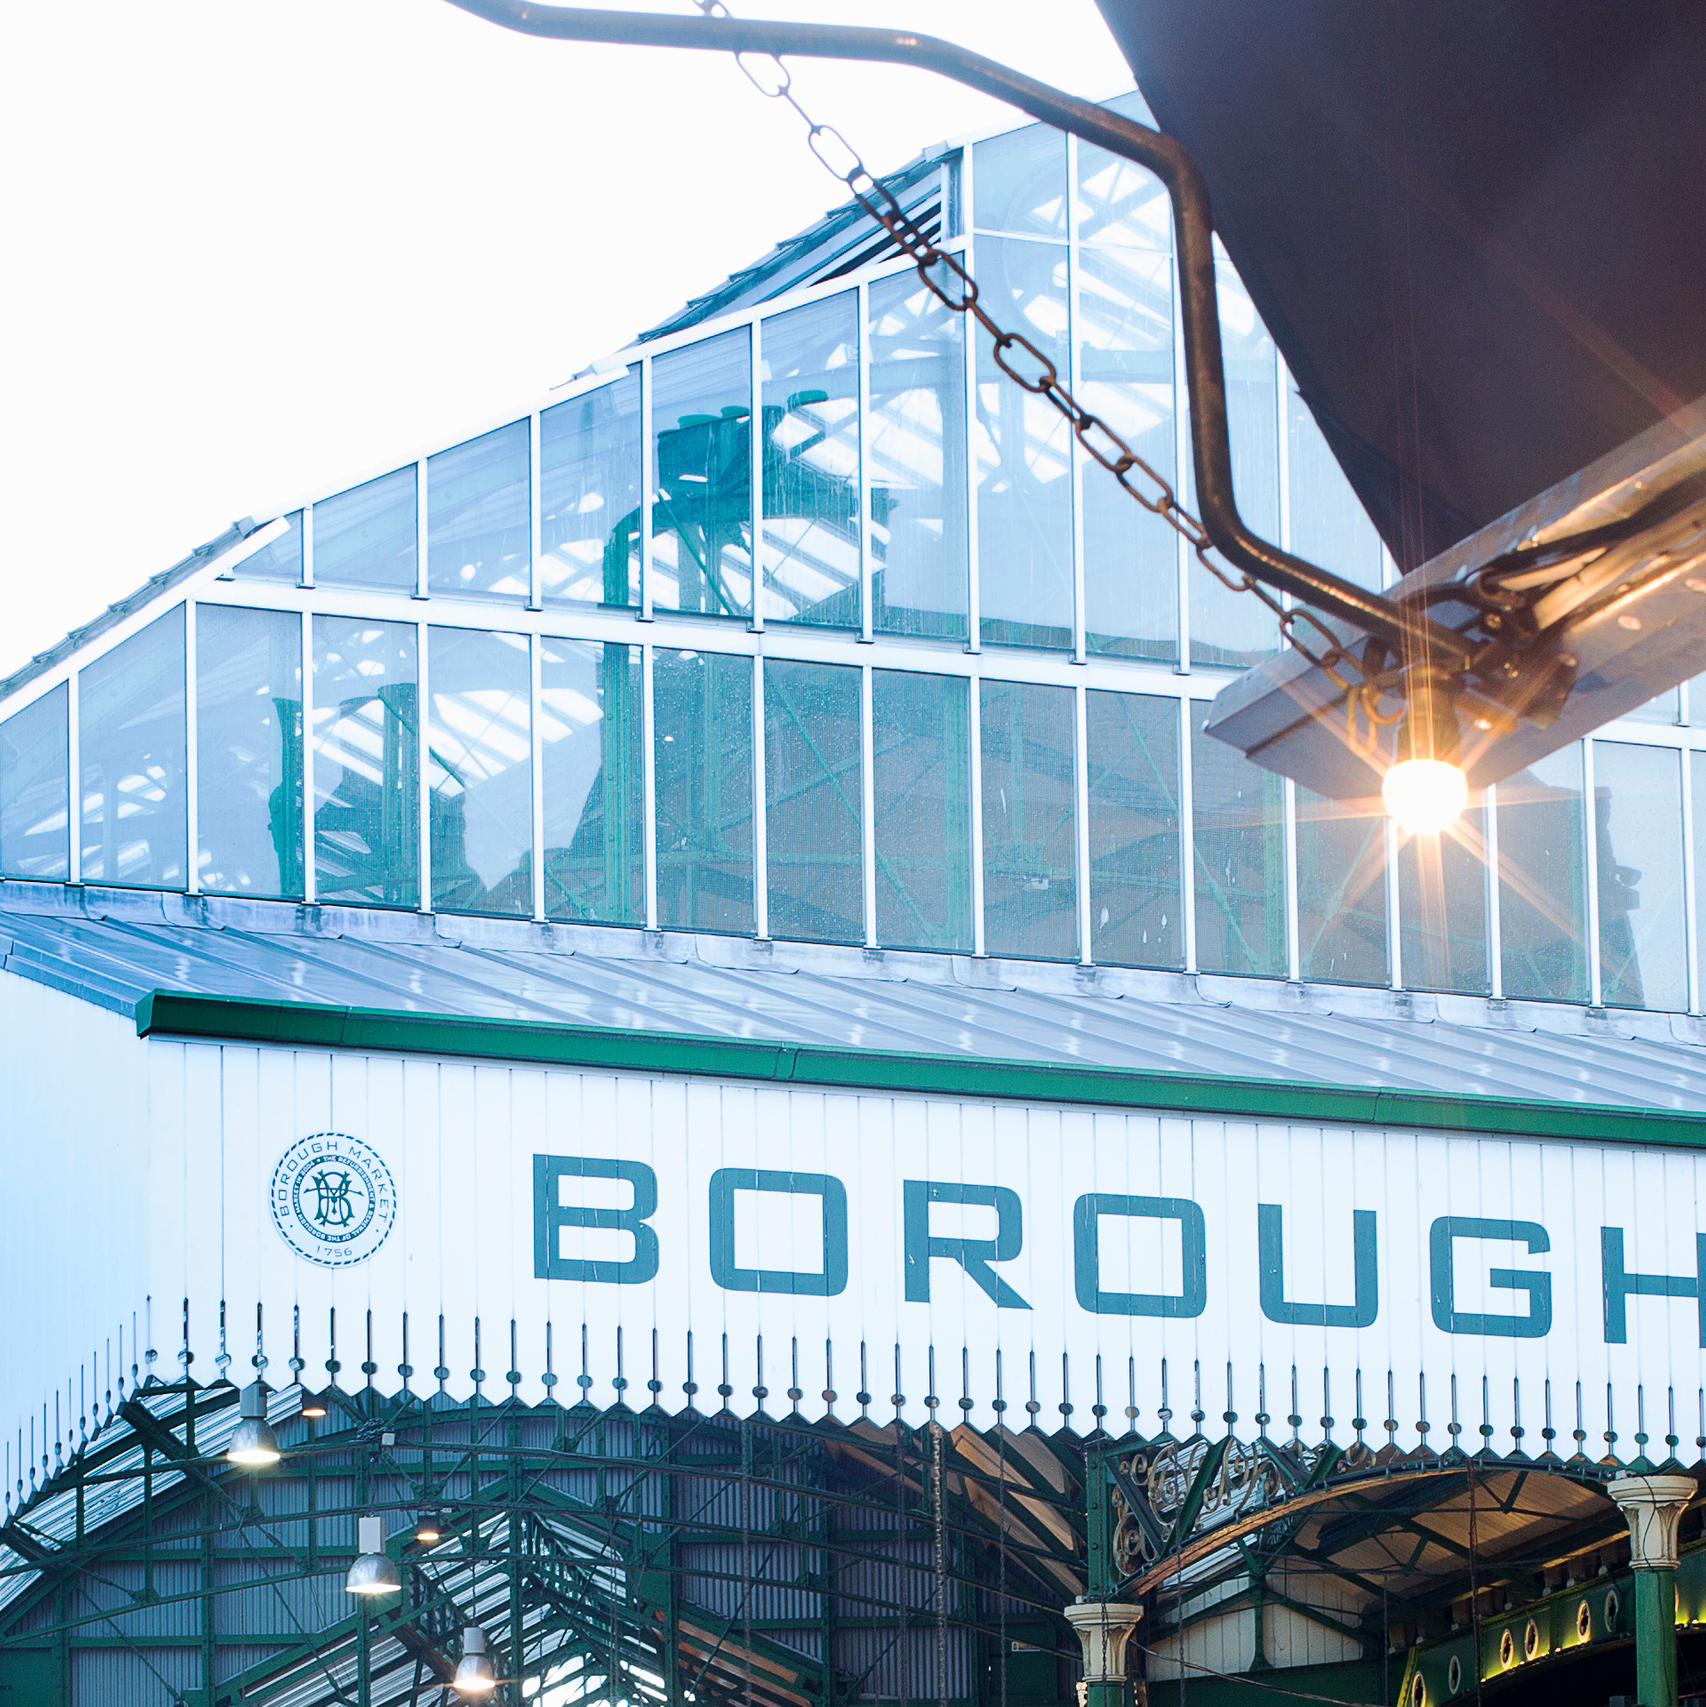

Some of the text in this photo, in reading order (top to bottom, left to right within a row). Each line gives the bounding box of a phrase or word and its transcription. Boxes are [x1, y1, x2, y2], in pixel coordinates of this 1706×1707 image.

[278, 1141, 389, 1223] BOROUGH MARKET
[317, 1245, 353, 1258] 1756
